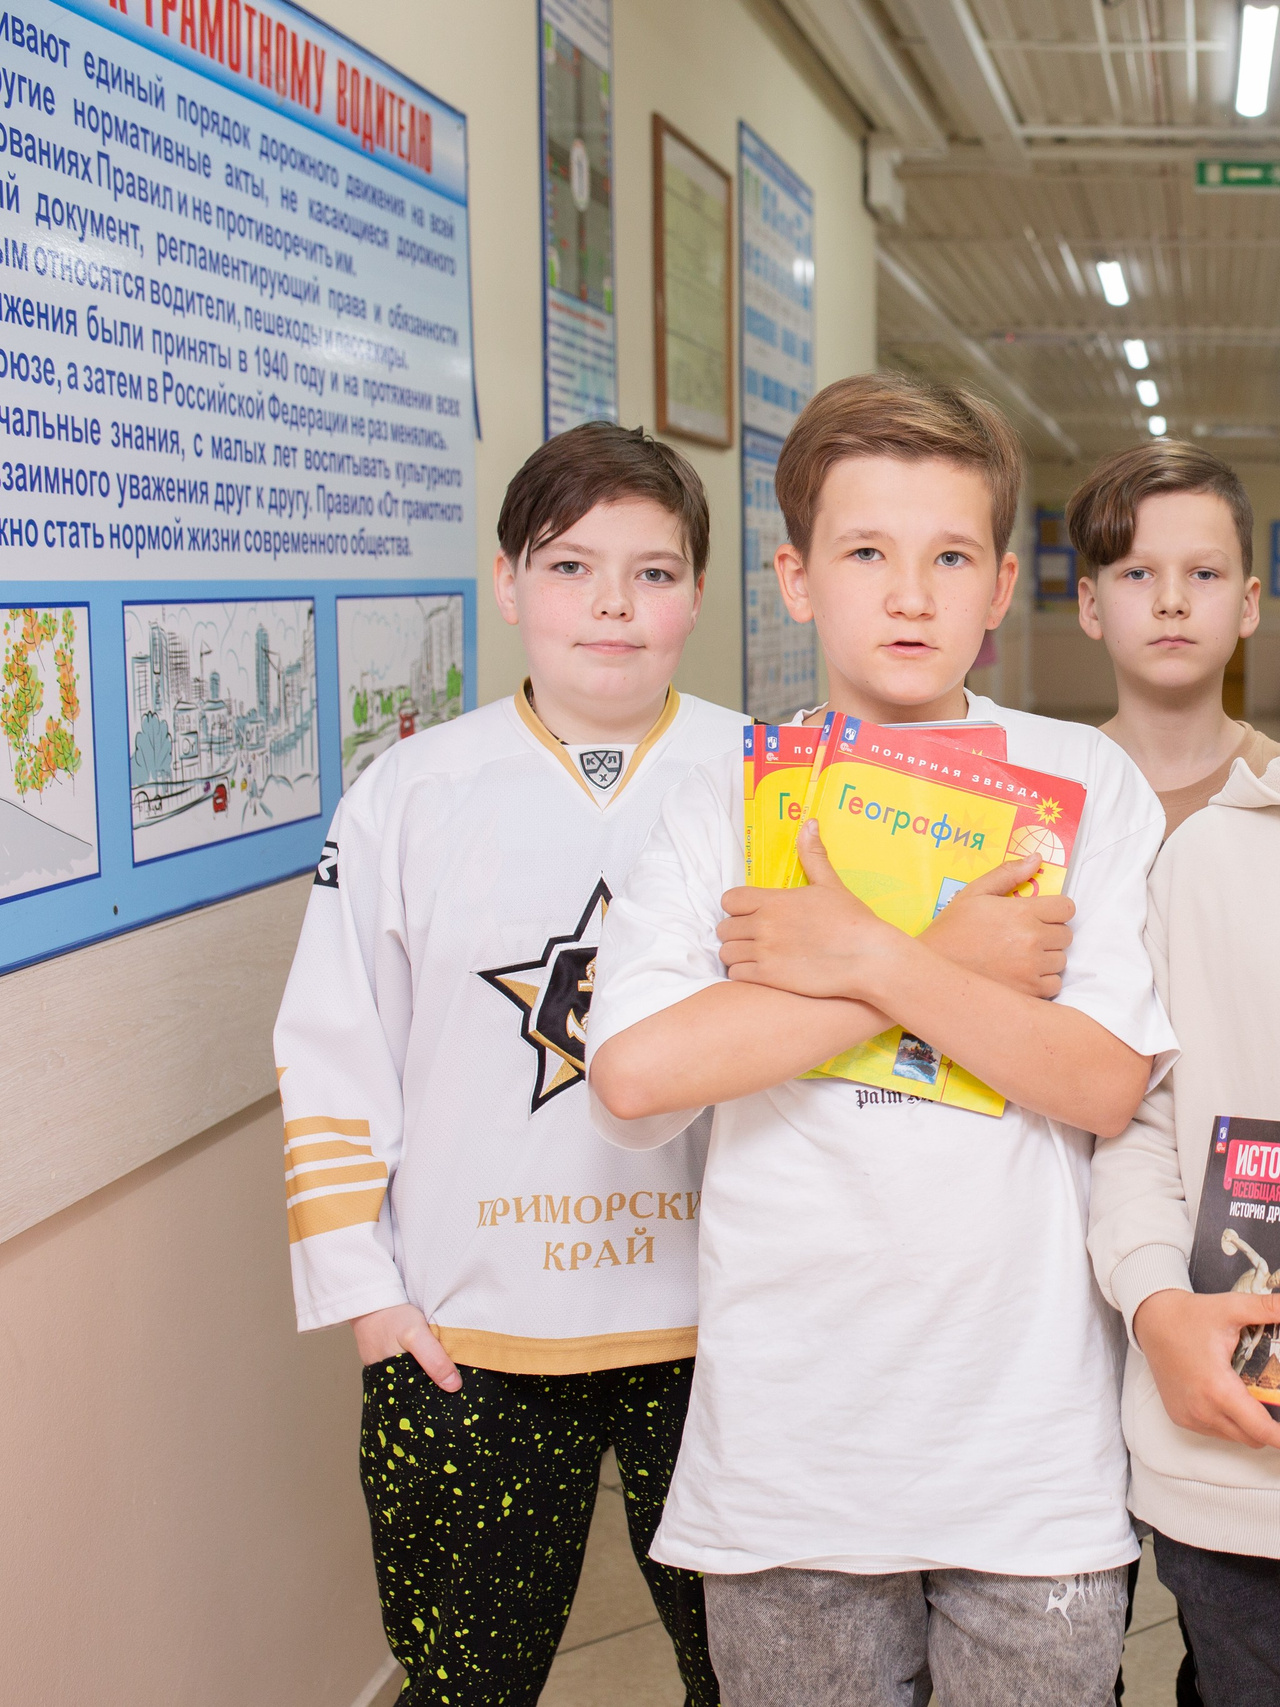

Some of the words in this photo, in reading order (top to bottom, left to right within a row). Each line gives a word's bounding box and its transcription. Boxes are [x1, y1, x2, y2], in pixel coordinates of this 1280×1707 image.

[84, 50, 165, 112] единый
[177, 94, 251, 150] порядок
[259, 133, 340, 189] дорожного
[336, 57, 433, 175] ВОДИТЕЛЮ
[73, 98, 212, 179] нормативные
[225, 162, 270, 208] акты,
[280, 186, 298, 213] не
[308, 197, 390, 250] касающиеся
[97, 150, 174, 212] Правил
[178, 190, 189, 218] и
[193, 196, 212, 226] не
[216, 205, 333, 269] противоречить
[33, 246, 145, 302] относятся
[150, 279, 241, 333] водители,
[244, 304, 322, 349] пешеходы
[35, 192, 144, 258] документ,
[157, 231, 321, 307] регламентирующий
[328, 287, 367, 321] права
[374, 303, 382, 325] и
[86, 304, 144, 352] были
[152, 328, 232, 371] приняты
[238, 349, 248, 374] в
[254, 345, 288, 382] 1940
[294, 361, 326, 398] году
[330, 370, 339, 392] и
[343, 373, 360, 398] на
[67, 361, 79, 391] а
[83, 363, 143, 401] затем
[147, 377, 159, 403] в
[162, 370, 265, 421] Российской
[268, 392, 350, 438] Федерации
[350, 415, 366, 438] не
[368, 417, 389, 445] раз
[0, 461, 110, 498] заимного
[116, 472, 209, 509] уважения
[214, 481, 251, 515] друг
[255, 485, 265, 509] к
[268, 486, 313, 520] другу.
[316, 483, 374, 521] Правило
[110, 420, 185, 461] знания,
[193, 432, 203, 458] с
[211, 434, 267, 465] малых
[273, 443, 298, 470] лет
[303, 448, 391, 481] воспитывать
[43, 519, 105, 549] стать
[109, 516, 184, 559] нормой
[187, 525, 240, 553] жизни
[244, 528, 348, 561] современного
[350, 526, 413, 560] общества.
[871, 743, 961, 778] ПОЛЯРНАЯ
[971, 773, 1039, 799] ЗВЕЗДА
[838, 782, 986, 852] География
[542, 1226, 655, 1271] КРАЙ
[1229, 1201, 1265, 1220] ИСТОРИЯ
